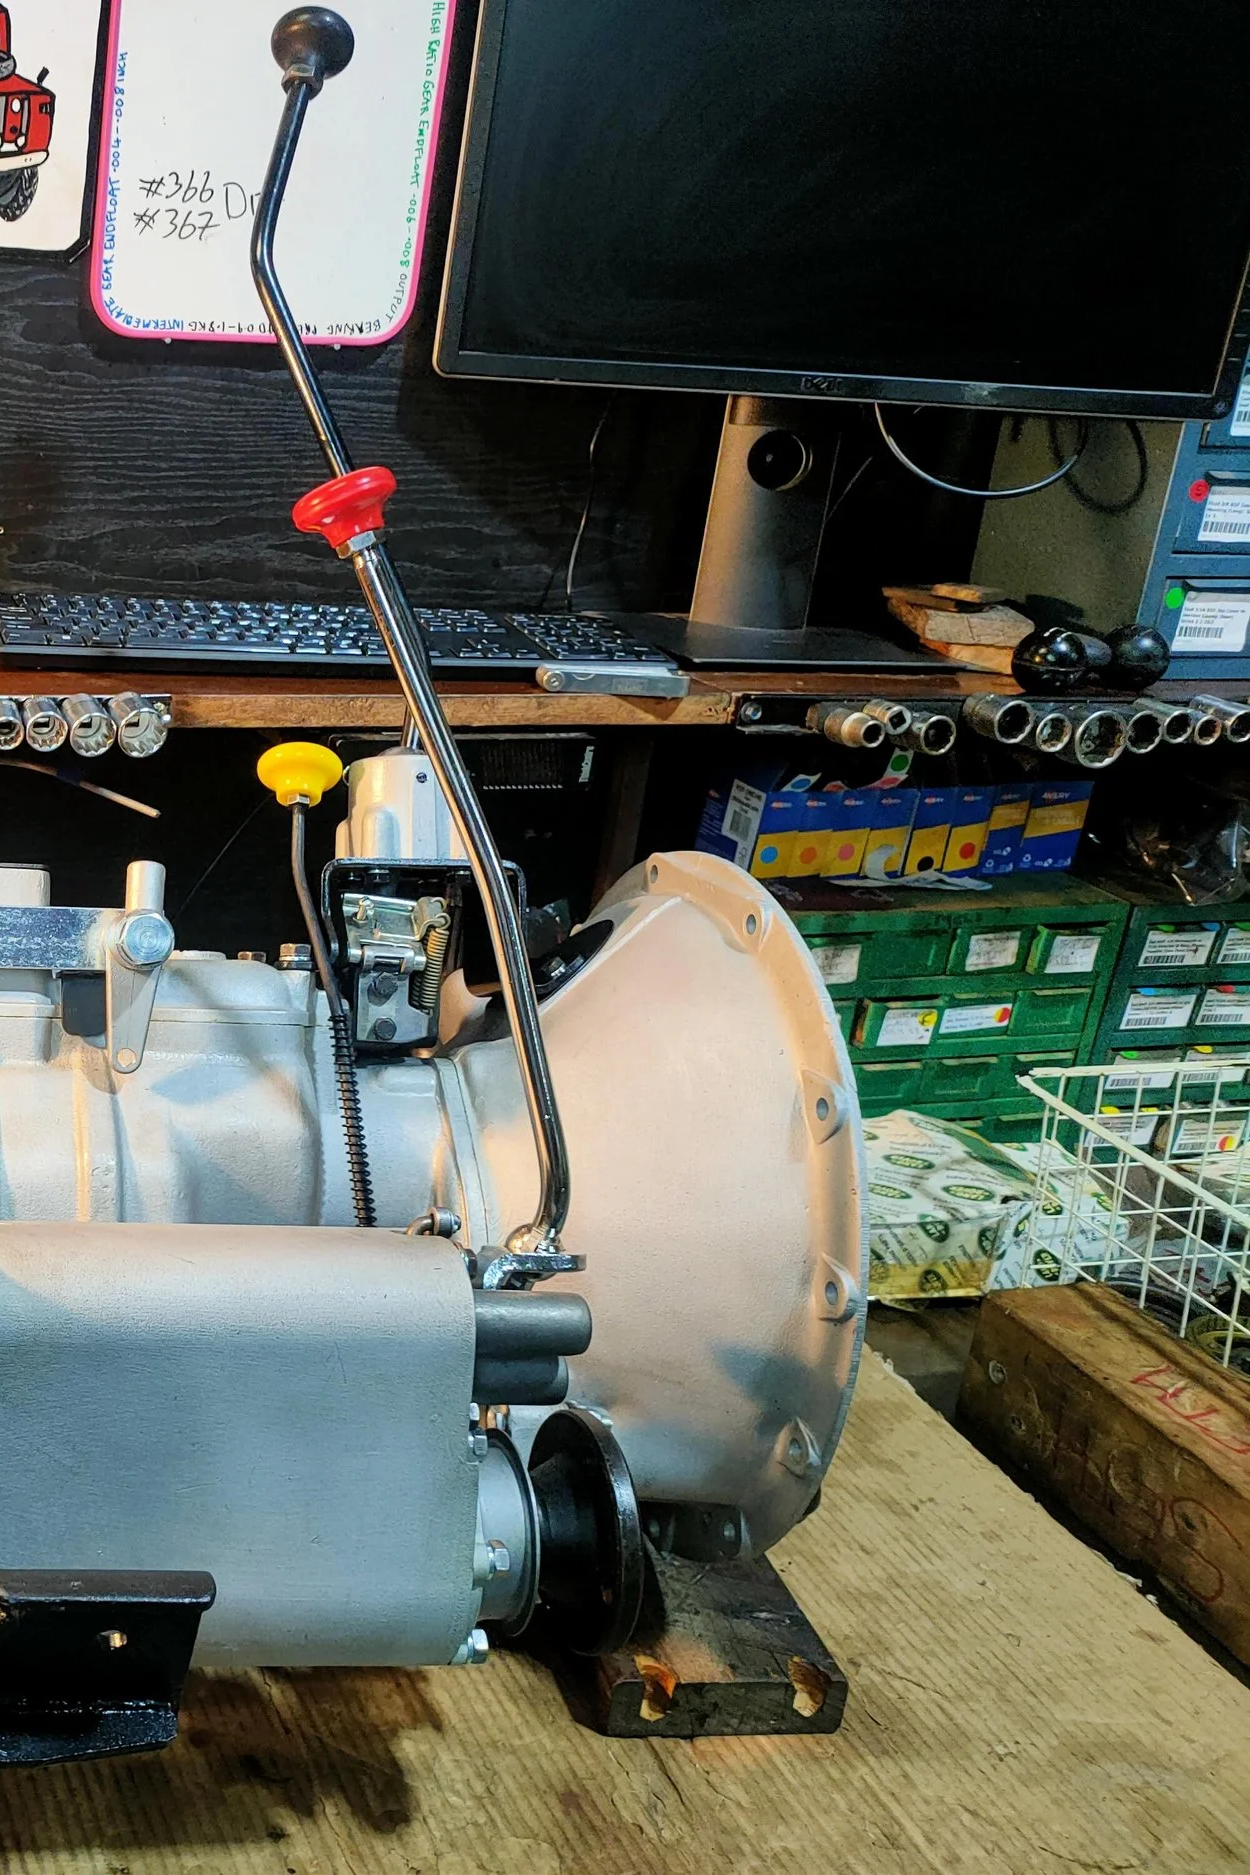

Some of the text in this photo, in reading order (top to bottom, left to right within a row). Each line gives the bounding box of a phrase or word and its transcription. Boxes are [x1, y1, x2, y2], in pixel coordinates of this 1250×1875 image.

[430, 1, 446, 35] HIGH
[117, 51, 129, 82] INCH
[425, 39, 441, 78] RATIO
[419, 80, 435, 117] GEAR
[138, 169, 215, 203] #366
[103, 176, 121, 250] ENDFLOAT
[133, 207, 221, 242] #367
[101, 254, 115, 291] GEAR
[103, 297, 184, 331] INTERMEDIATE
[385, 273, 408, 324] OUTPUT
[327, 318, 382, 336] BEARING
